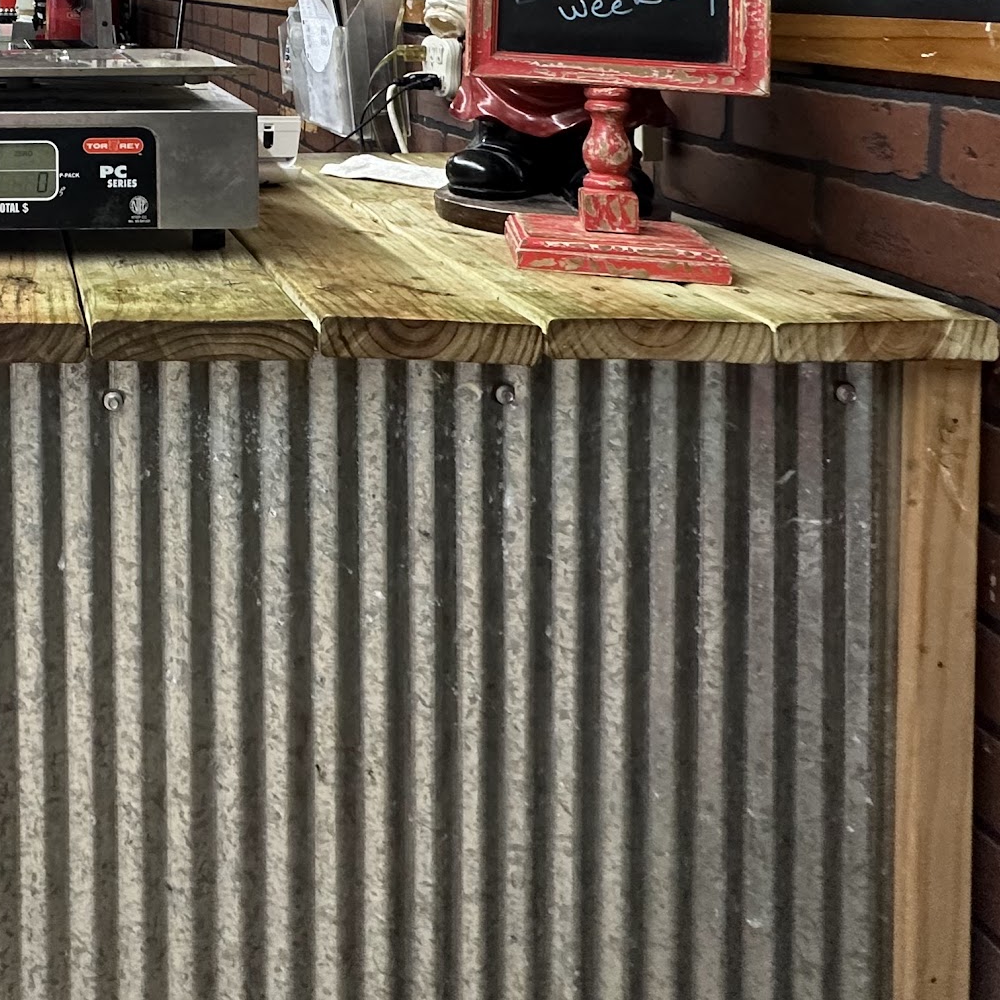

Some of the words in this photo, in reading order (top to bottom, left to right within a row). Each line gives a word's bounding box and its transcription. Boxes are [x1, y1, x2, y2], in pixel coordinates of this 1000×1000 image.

[99, 165, 128, 179] PC
[37, 172, 49, 193] 0
[107, 179, 138, 188] SERIES
[21, 202, 29, 214] $
